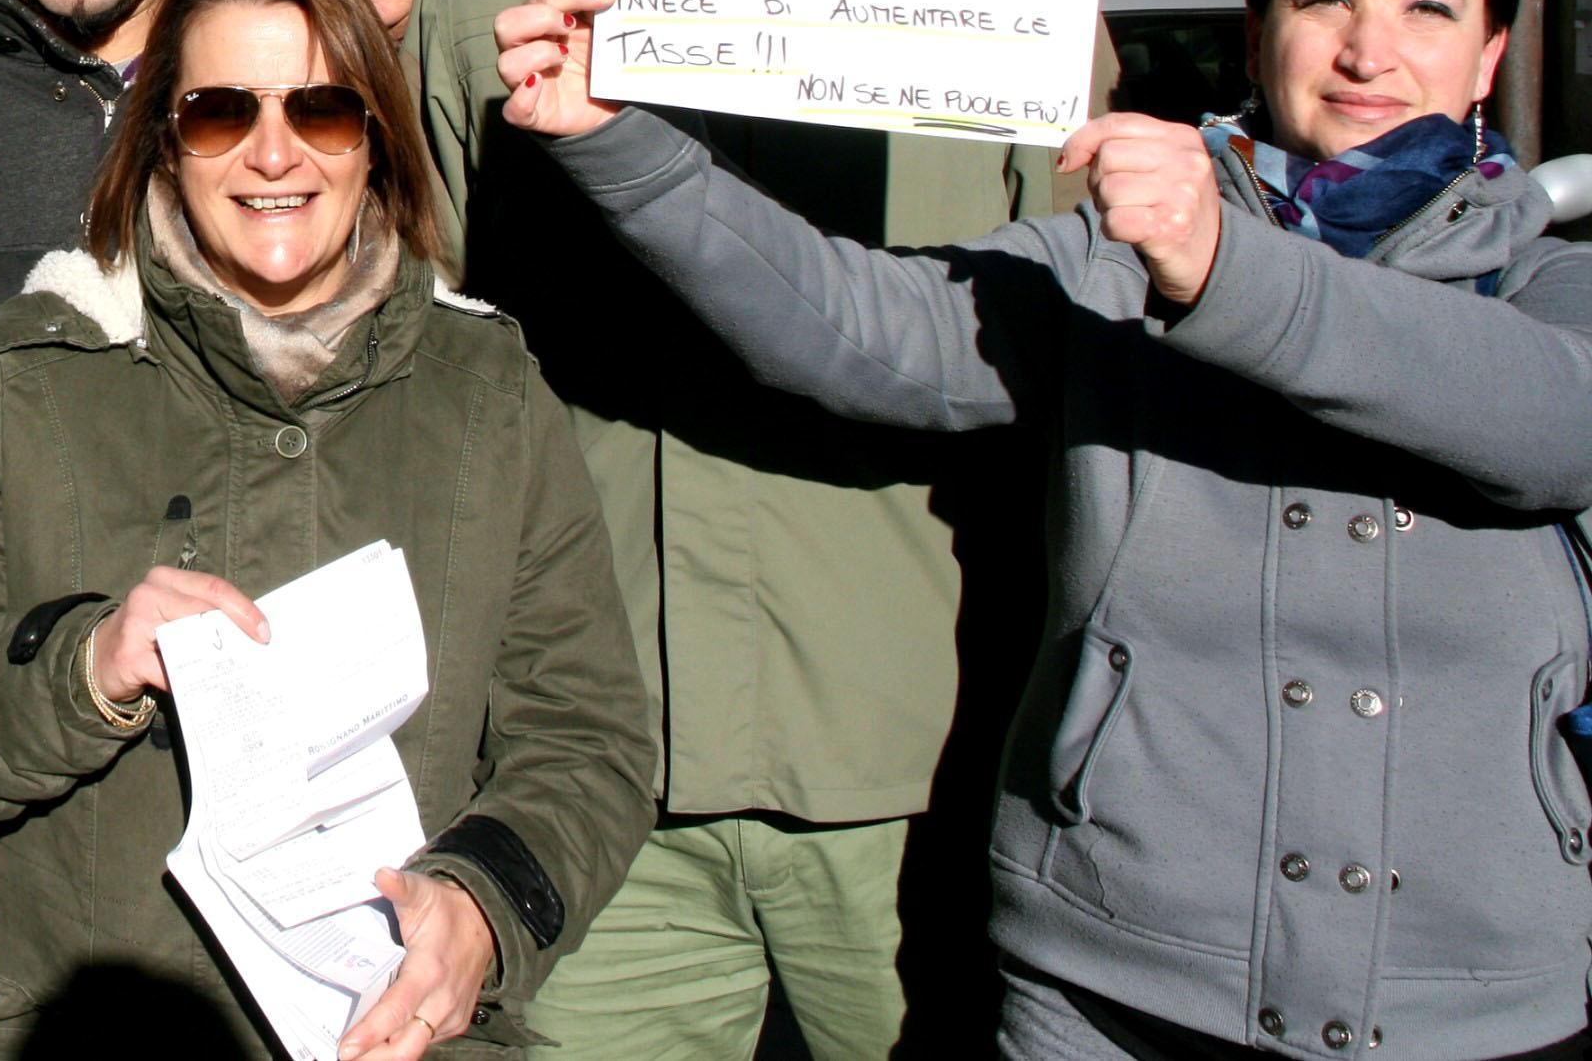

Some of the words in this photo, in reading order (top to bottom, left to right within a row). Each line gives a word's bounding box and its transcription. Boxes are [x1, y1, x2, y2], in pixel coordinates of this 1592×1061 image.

[1013, 16, 1050, 35] LE
[606, 29, 737, 66] TASSE
[797, 73, 845, 102] NON
[854, 82, 890, 105] SE
[898, 85, 931, 109] NE
[944, 90, 1014, 117] PUOLE
[362, 693, 409, 727] MARITTIMO
